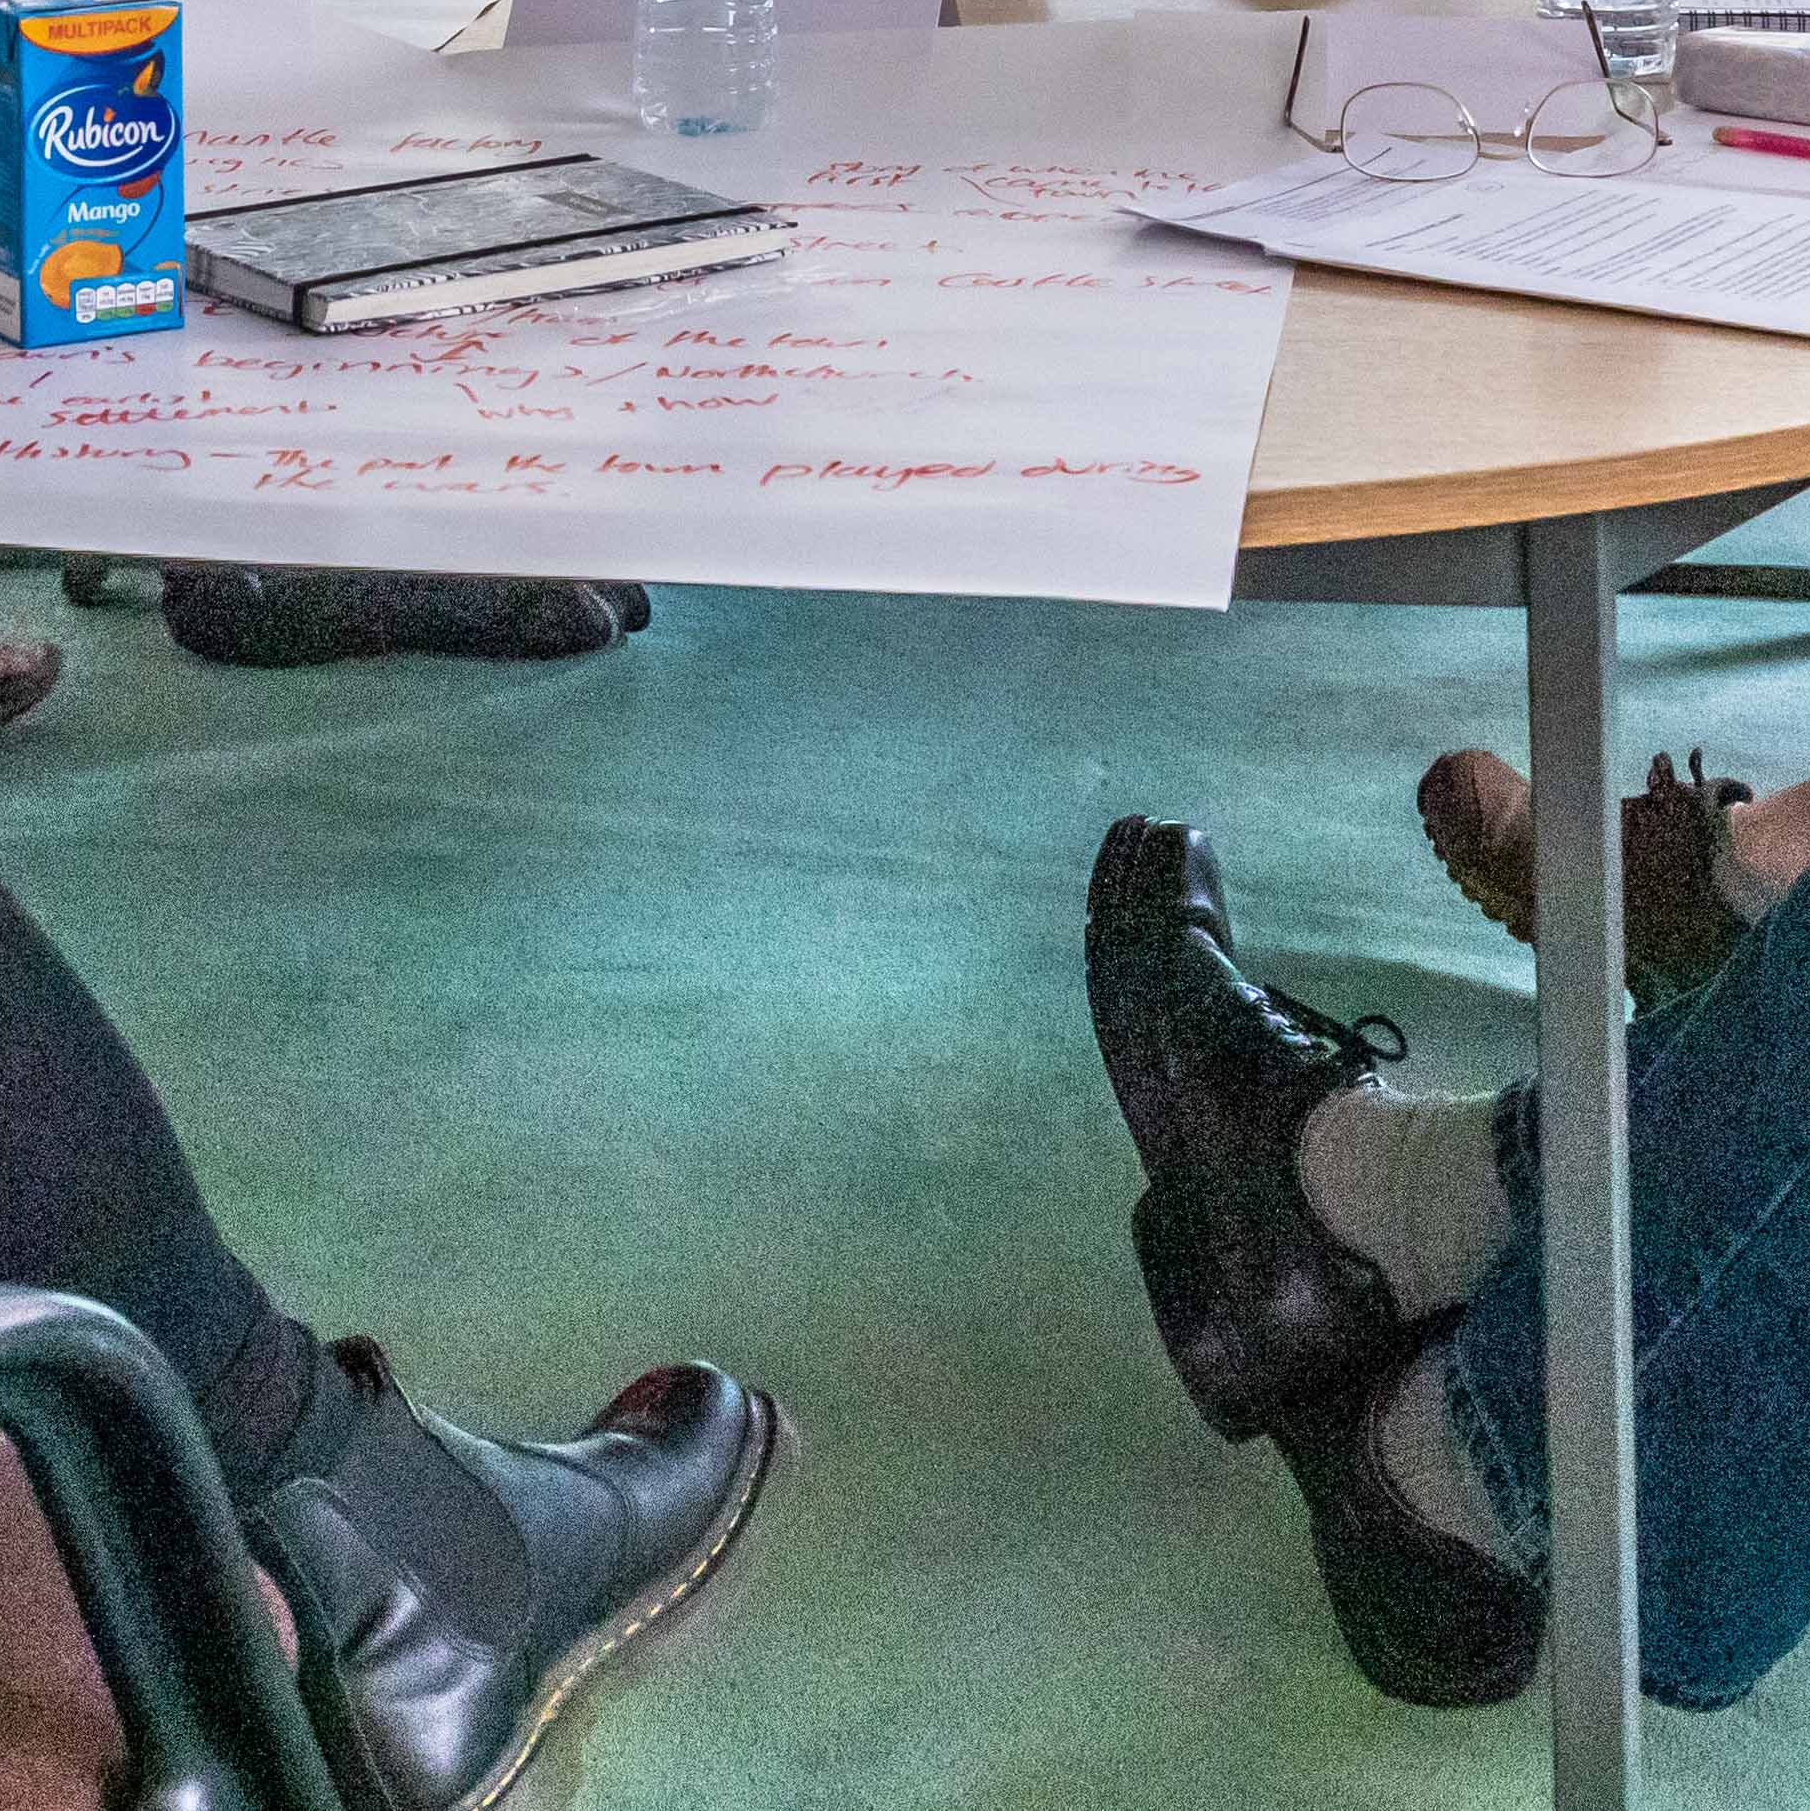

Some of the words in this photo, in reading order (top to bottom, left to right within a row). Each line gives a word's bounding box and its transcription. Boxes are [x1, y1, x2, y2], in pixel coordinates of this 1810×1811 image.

[47, 16, 152, 40] MULTIPACK
[38, 104, 165, 167] Rubicon
[67, 201, 141, 224] Mango
[758, 459, 998, 492] played
[1019, 455, 1204, 486] during
